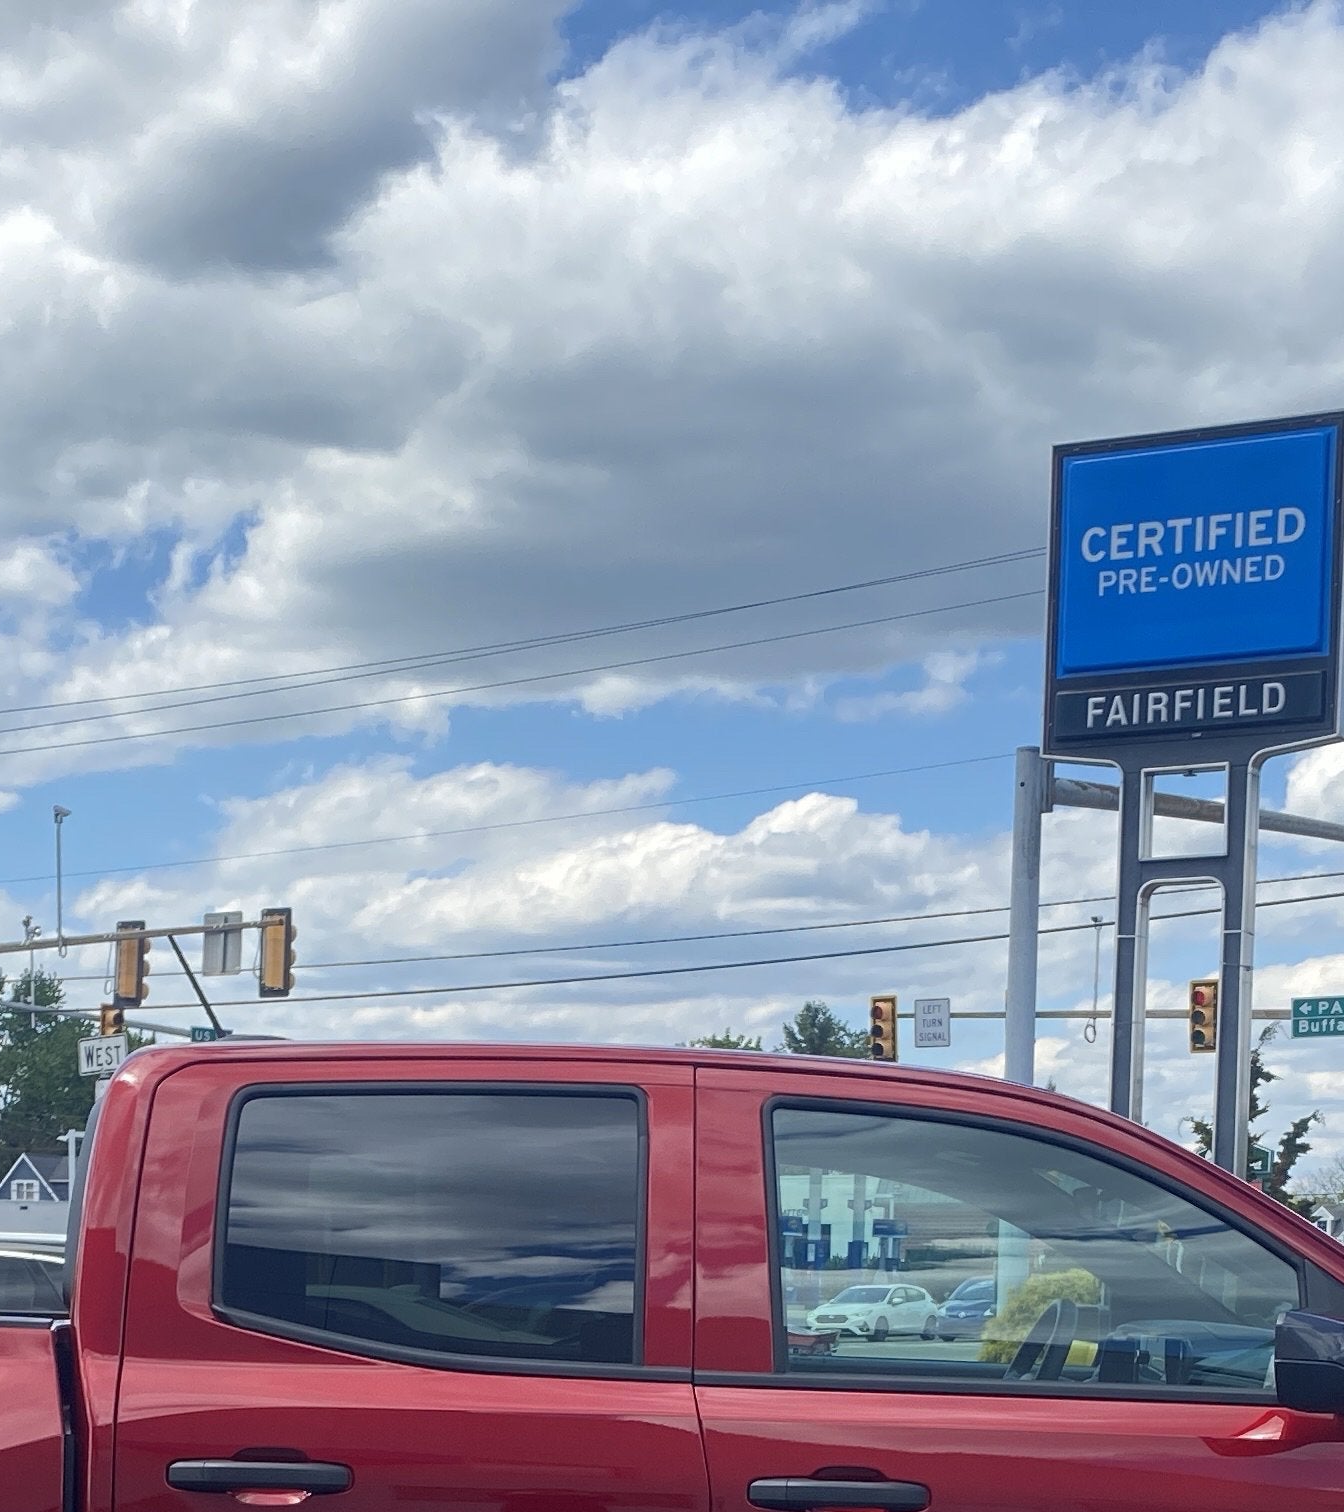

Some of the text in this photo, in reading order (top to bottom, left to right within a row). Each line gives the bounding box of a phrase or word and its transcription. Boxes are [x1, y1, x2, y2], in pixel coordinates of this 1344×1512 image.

[1081, 507, 1306, 563] CERTIFIED
[1098, 554, 1285, 596] PRE-OWNED
[1086, 682, 1287, 729] FAIRFIELD
[922, 1005, 942, 1015] LEFT
[1318, 1001, 1343, 1014] PA
[922, 1018, 943, 1028] TURN
[194, 1030, 211, 1041] US
[918, 1032, 947, 1042] SIGNAL
[84, 1045, 121, 1068] WEST
